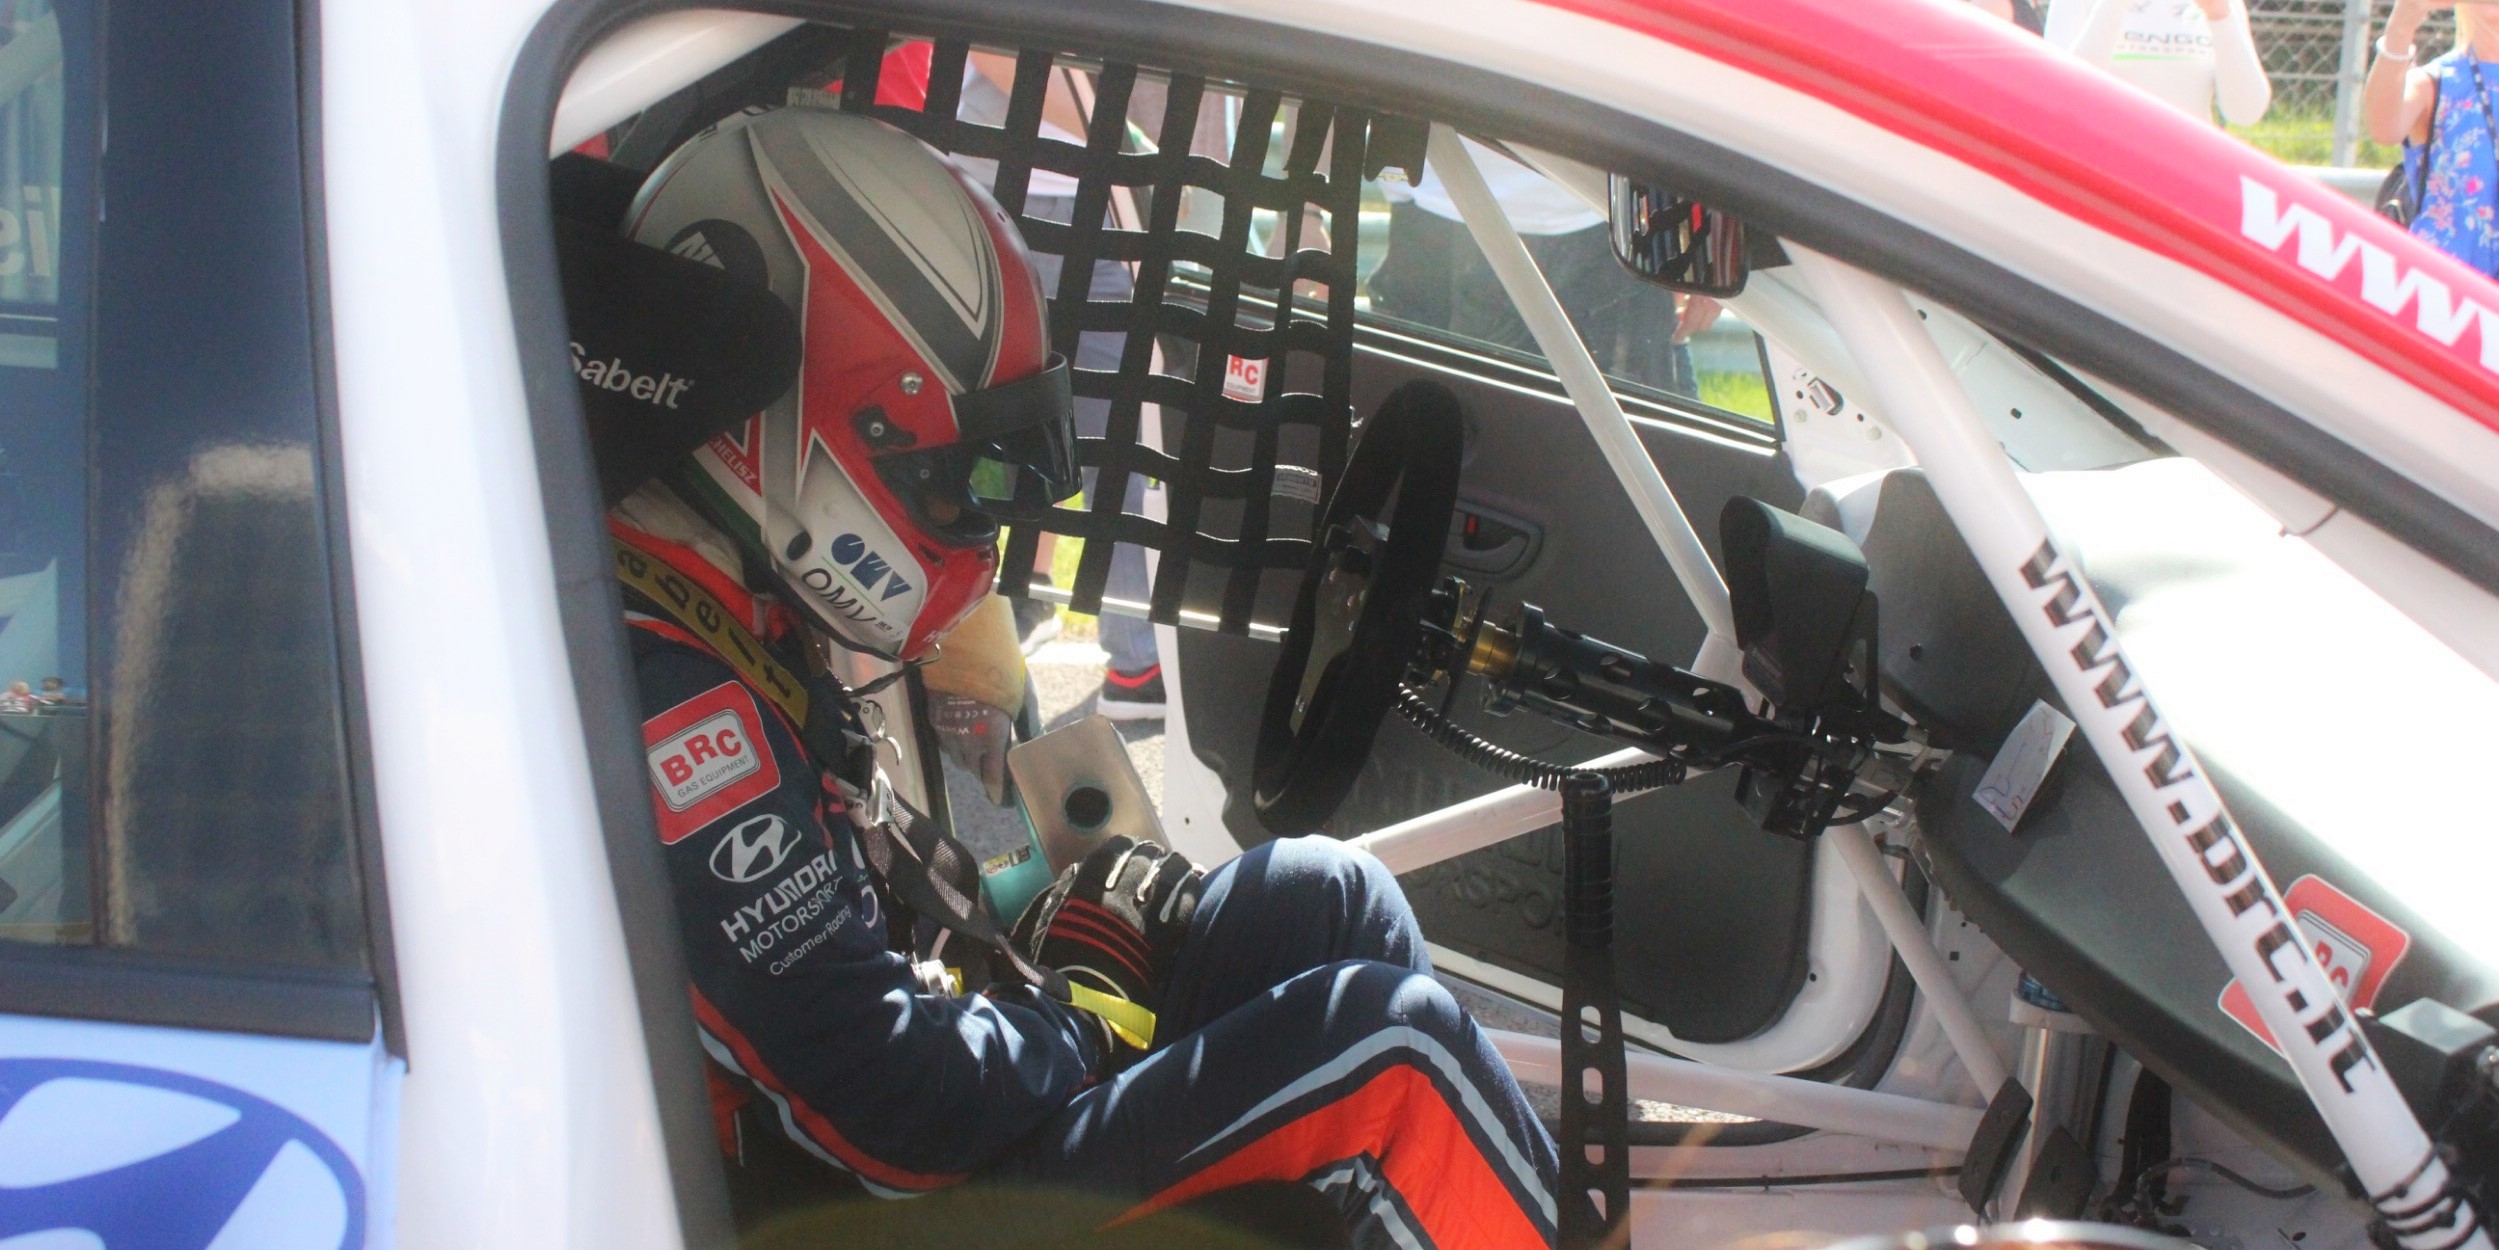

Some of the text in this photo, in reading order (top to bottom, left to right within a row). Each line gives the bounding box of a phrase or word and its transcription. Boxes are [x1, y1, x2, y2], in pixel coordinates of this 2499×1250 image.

[2238, 175, 2499, 377] ww
[1229, 356, 1259, 386] RC
[709, 439, 758, 485] HELISZ
[802, 567, 877, 623] OMV
[831, 533, 913, 602] OMV
[616, 550, 792, 699] abelt
[660, 728, 742, 787] BRC
[677, 755, 750, 798] GAS EQUIPMENT
[2019, 537, 2377, 1096] www.brc.it
[720, 849, 838, 943] HYUNDAI
[739, 875, 844, 964] MOTORSPORT
[769, 904, 852, 976] Customer Racing
